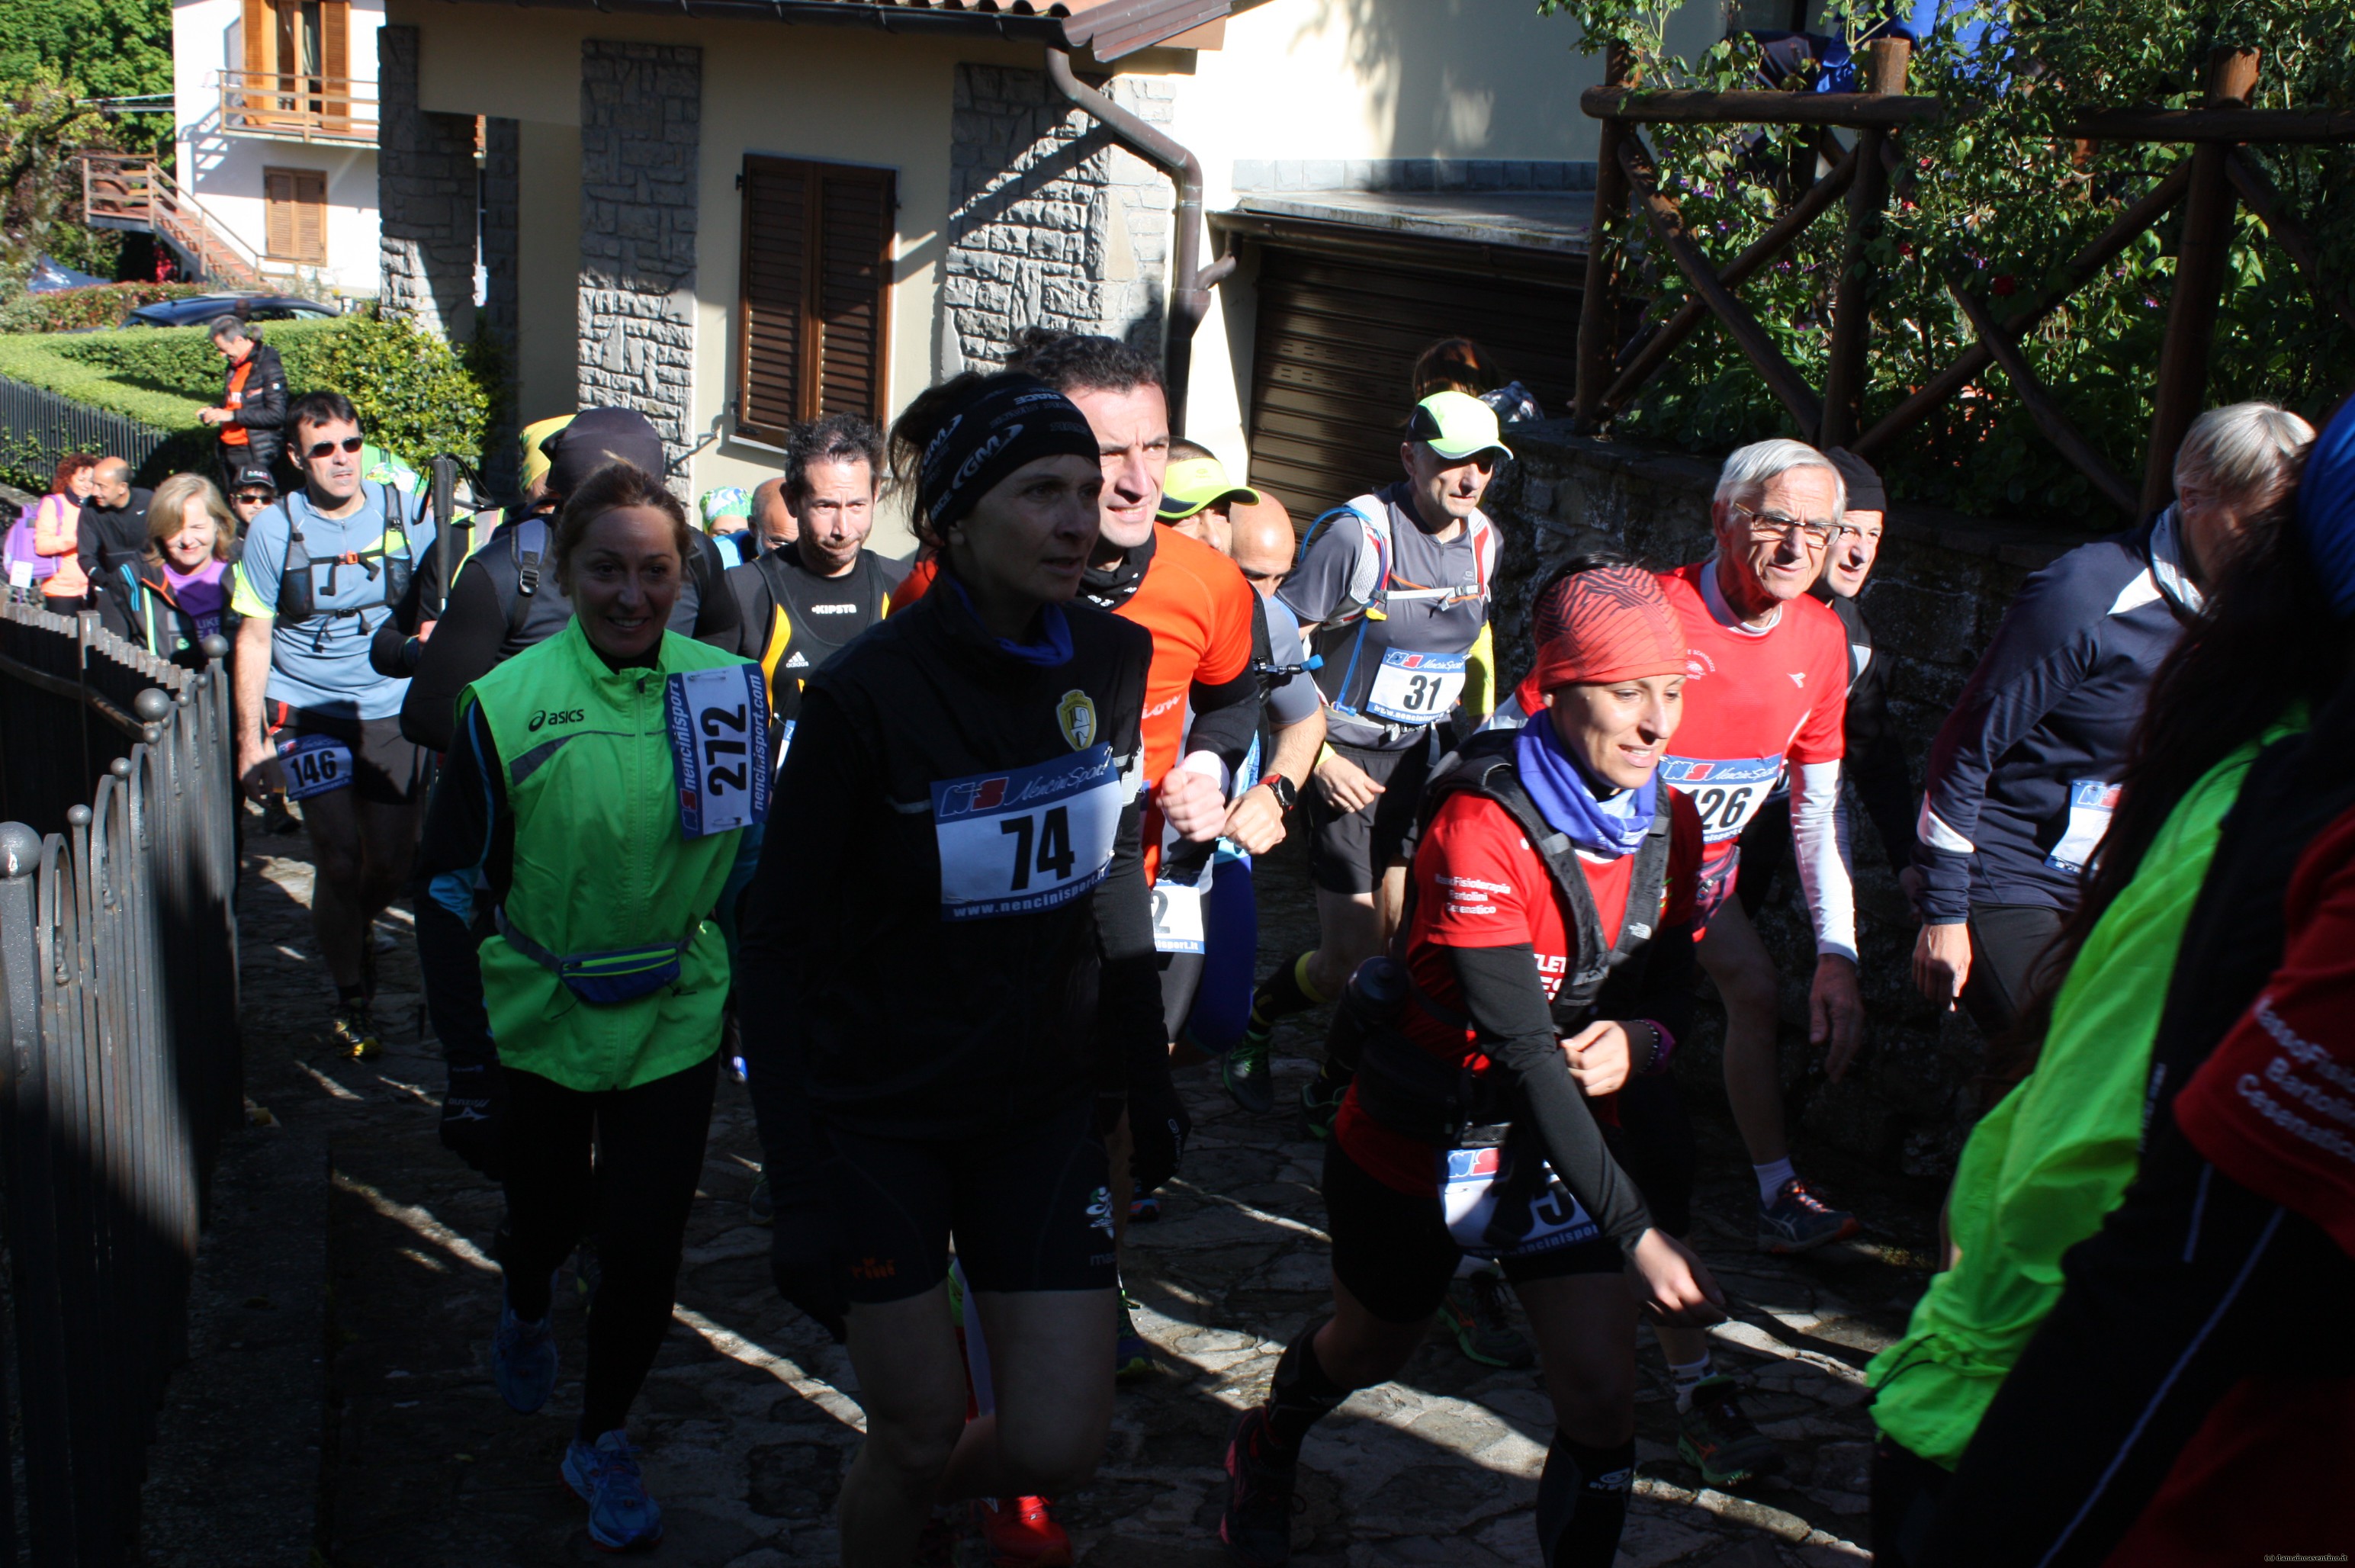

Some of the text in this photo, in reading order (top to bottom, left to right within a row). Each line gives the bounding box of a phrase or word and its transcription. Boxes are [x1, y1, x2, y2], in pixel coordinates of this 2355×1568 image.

[962, 434, 1002, 479] GM
[1402, 674, 1443, 711] 31
[548, 708, 585, 726] asics
[291, 750, 336, 787] 146
[700, 703, 747, 796] 212
[1000, 805, 1075, 891] 74
